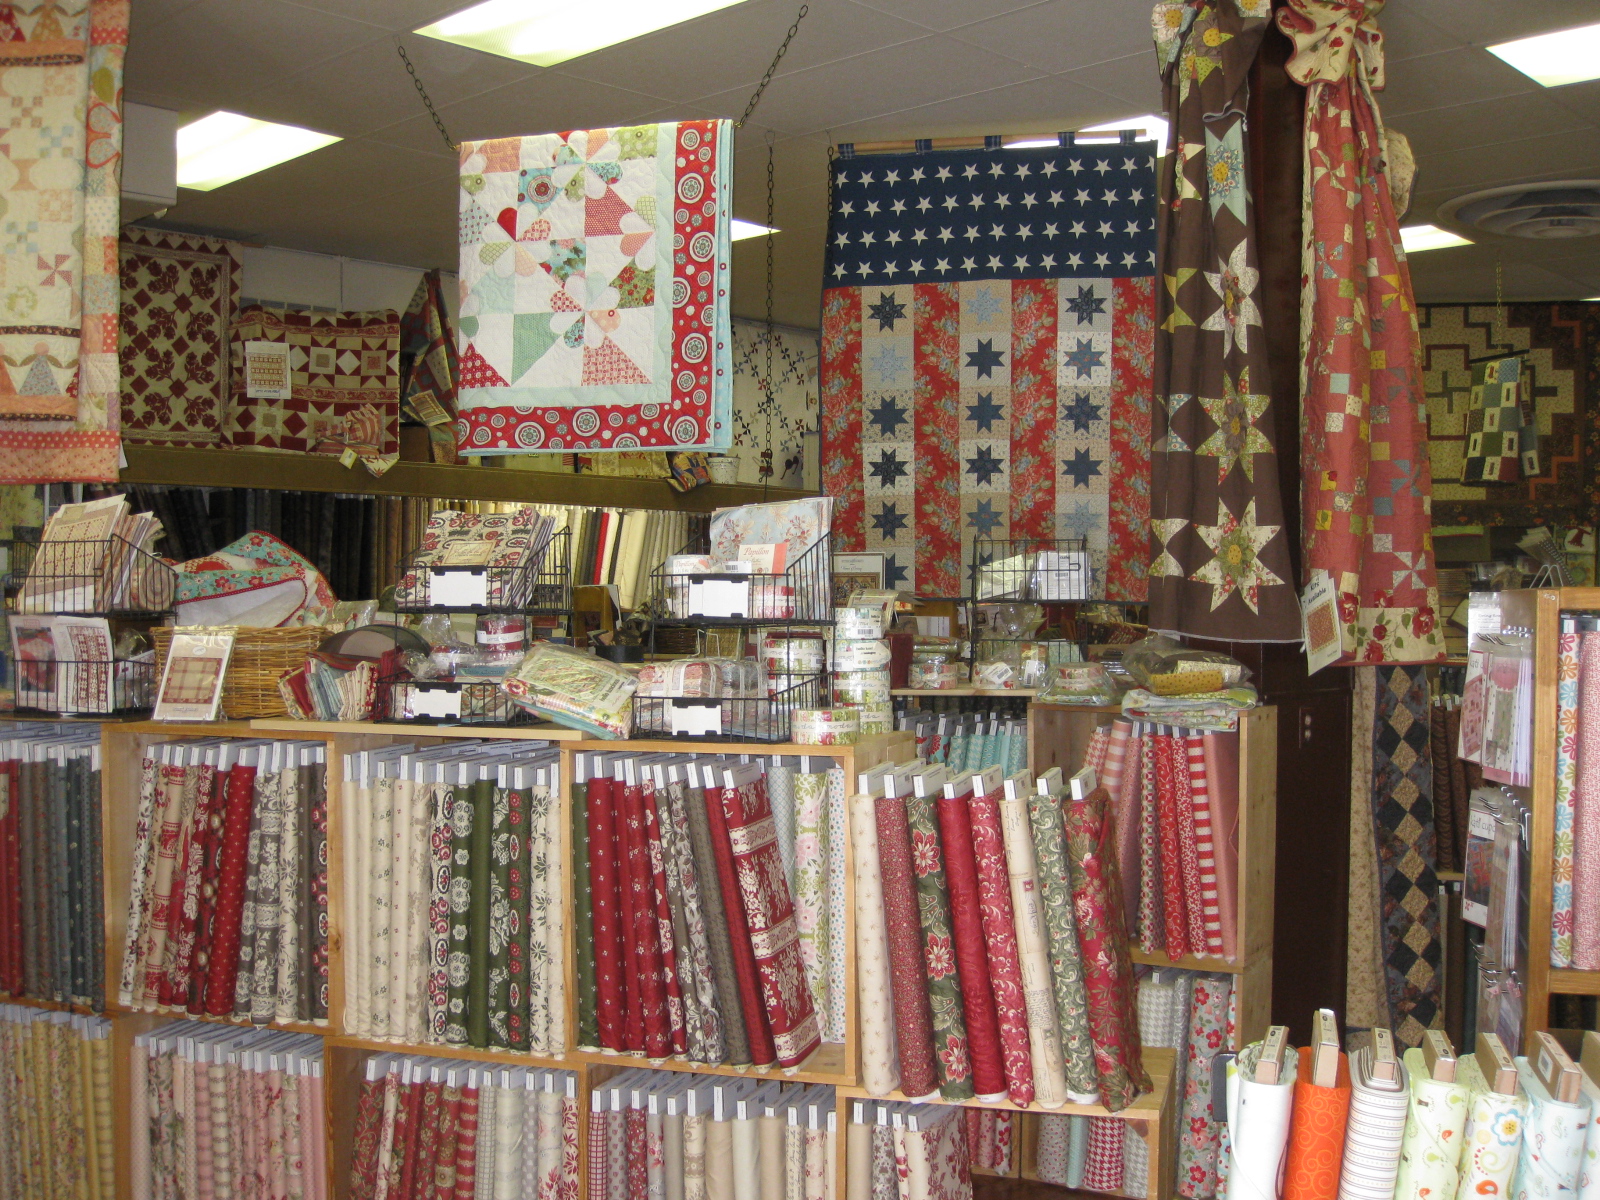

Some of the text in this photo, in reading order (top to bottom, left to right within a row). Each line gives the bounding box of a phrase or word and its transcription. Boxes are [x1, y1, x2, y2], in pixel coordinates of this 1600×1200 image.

[743, 547, 770, 556] Papillon
[1310, 582, 1320, 591] Kits
[1308, 587, 1327, 604] Available
[826, 722, 853, 730] moda
